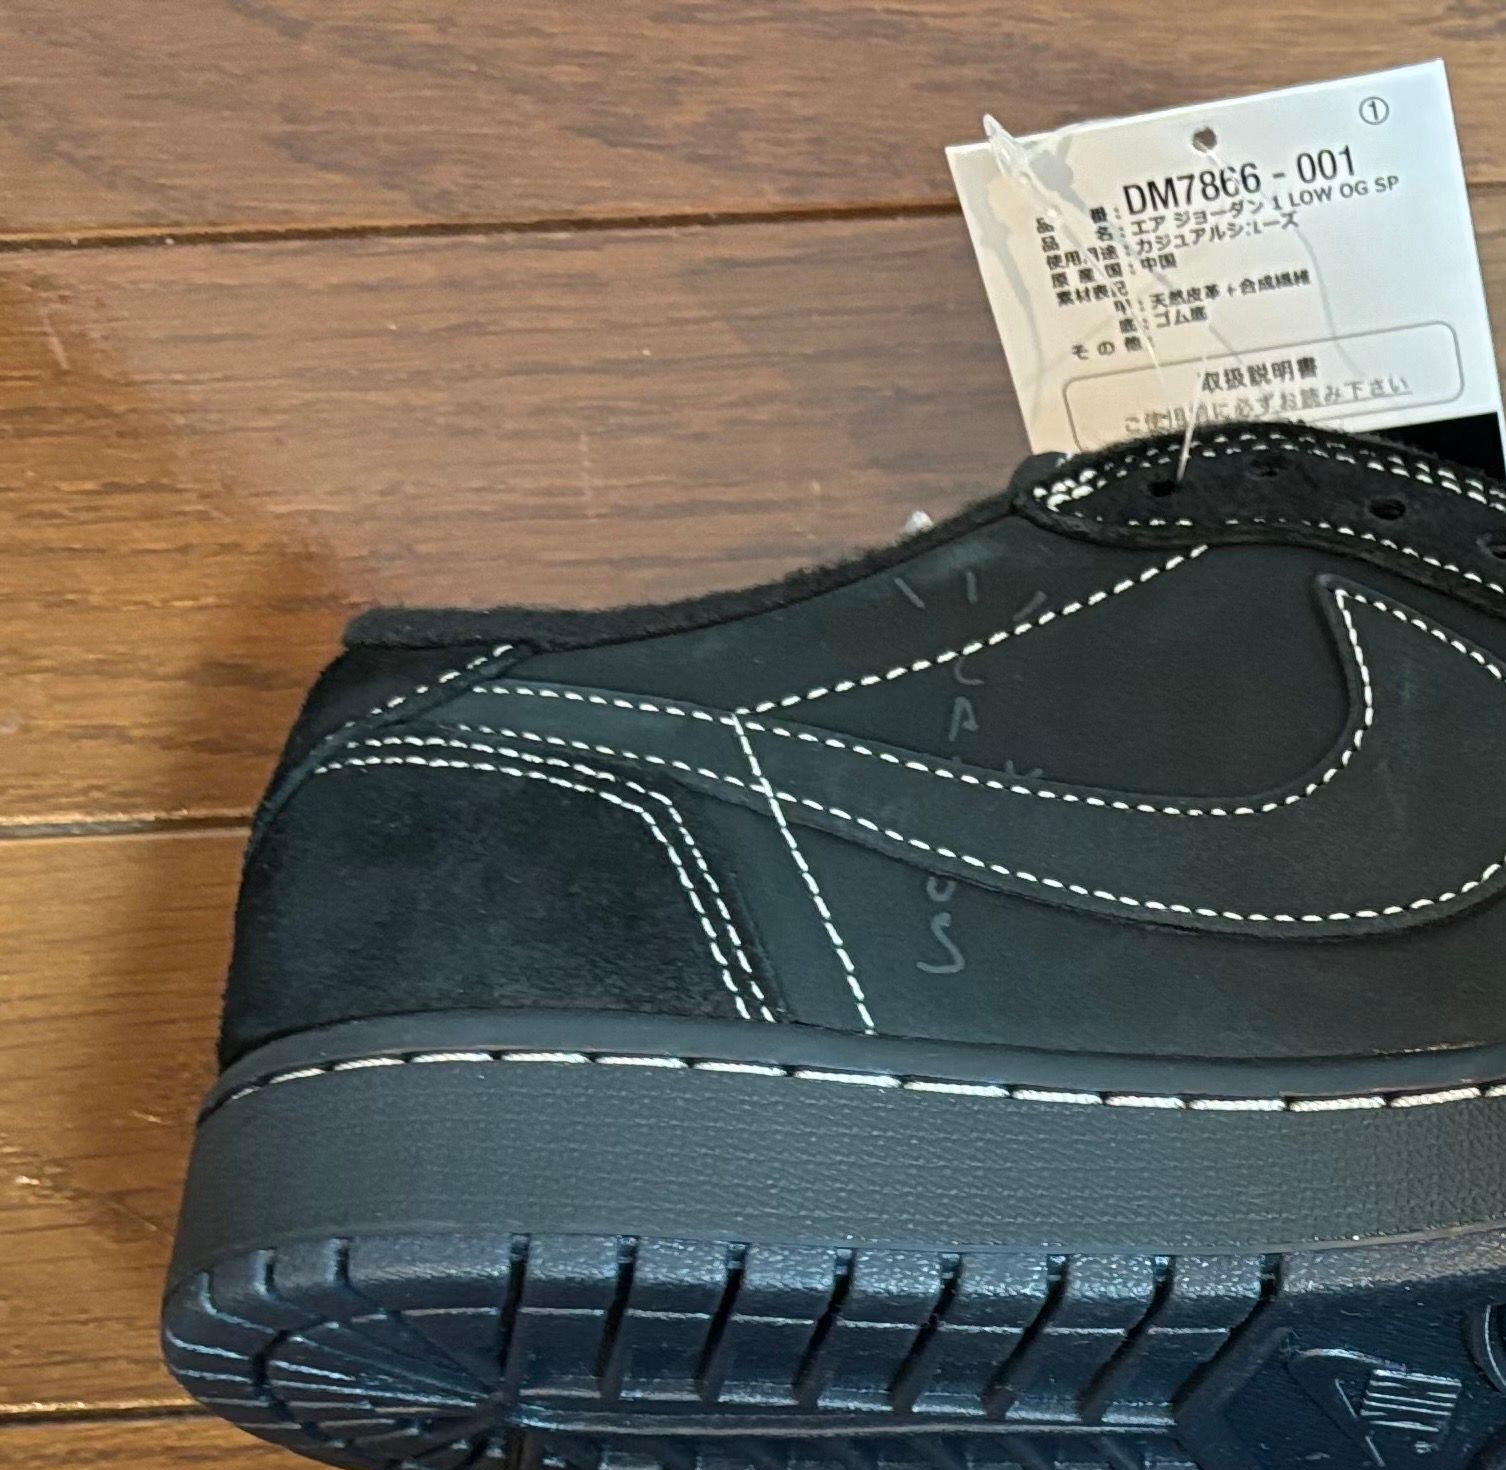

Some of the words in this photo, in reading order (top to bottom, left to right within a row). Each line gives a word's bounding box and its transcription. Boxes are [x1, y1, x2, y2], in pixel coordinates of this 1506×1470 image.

[1122, 162, 1261, 216] DM7866
[1296, 145, 1356, 185] 001
[1289, 187, 1332, 209] LOW
[1340, 180, 1370, 199] OG
[1374, 174, 1400, 193] SP
[1140, 252, 1177, 274] 中国
[1201, 356, 1319, 394] 取扱説明書
